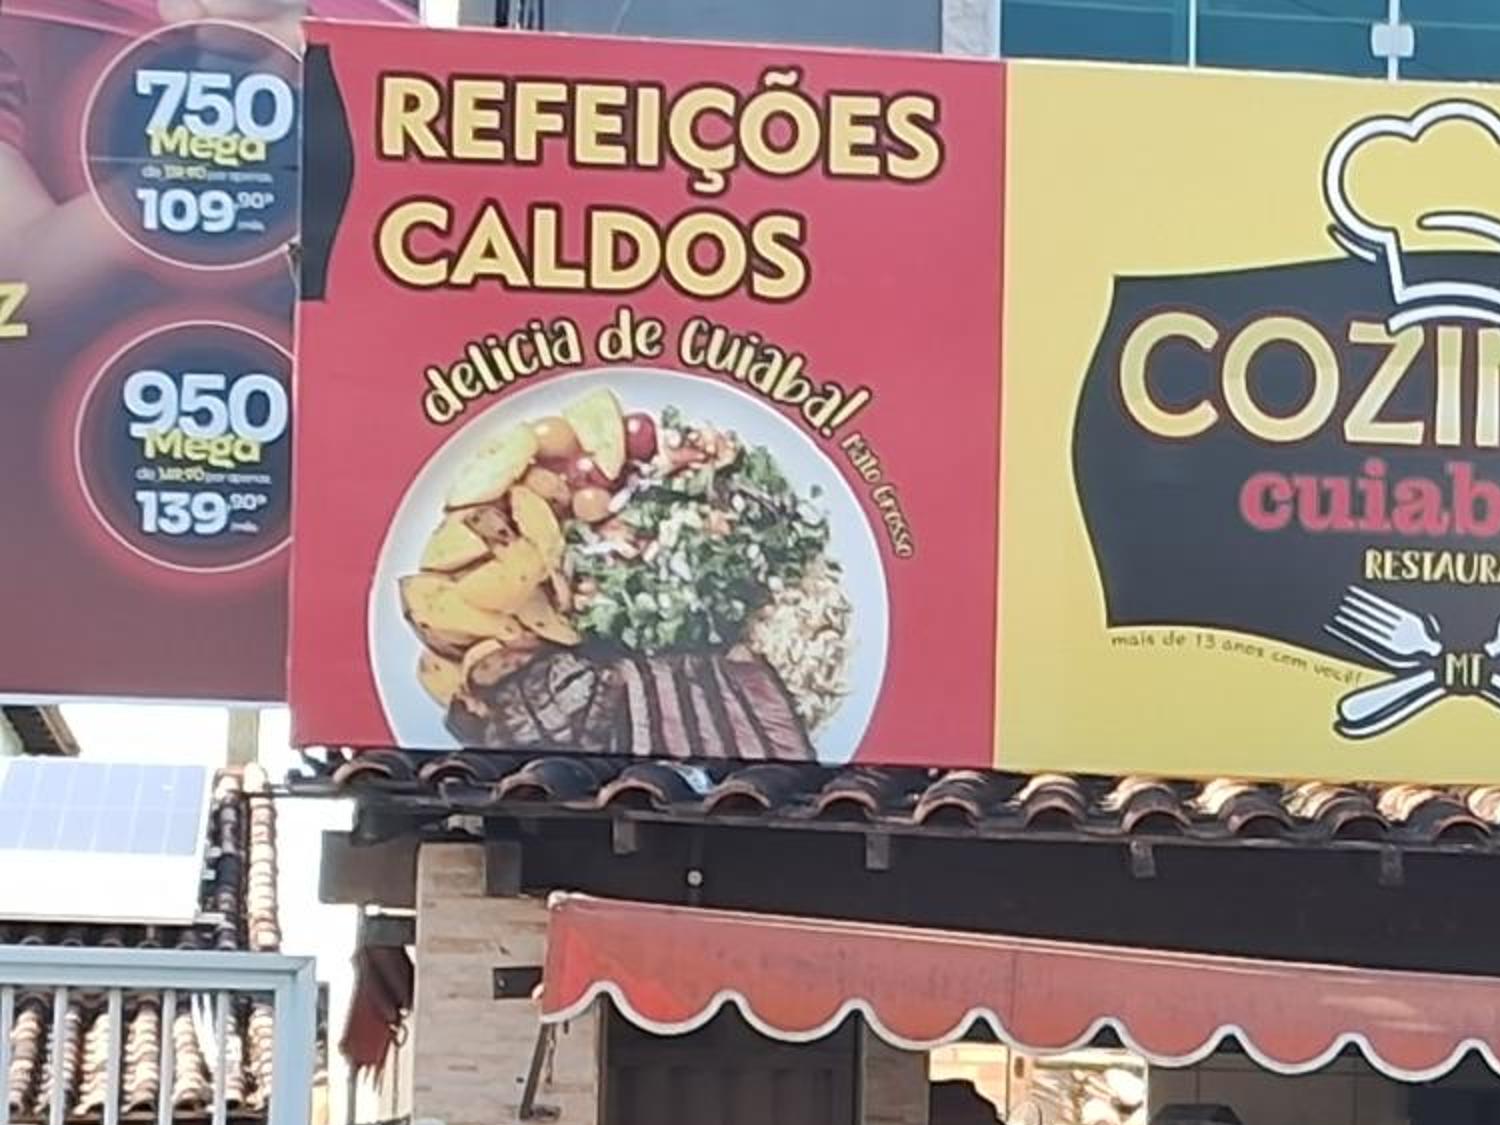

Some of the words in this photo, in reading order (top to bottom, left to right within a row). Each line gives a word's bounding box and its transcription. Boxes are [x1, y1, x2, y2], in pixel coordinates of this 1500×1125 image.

[136, 69, 294, 143] 750
[379, 70, 944, 193] REFEIÇÕES
[150, 125, 267, 166] Mega
[376, 200, 808, 299] CALDOS
[598, 308, 664, 360] de
[123, 369, 288, 443] 950
[142, 428, 261, 468] Mega
[1162, 631, 1188, 647] de
[1197, 634, 1216, 650] 13
[1444, 653, 1485, 688] MT
